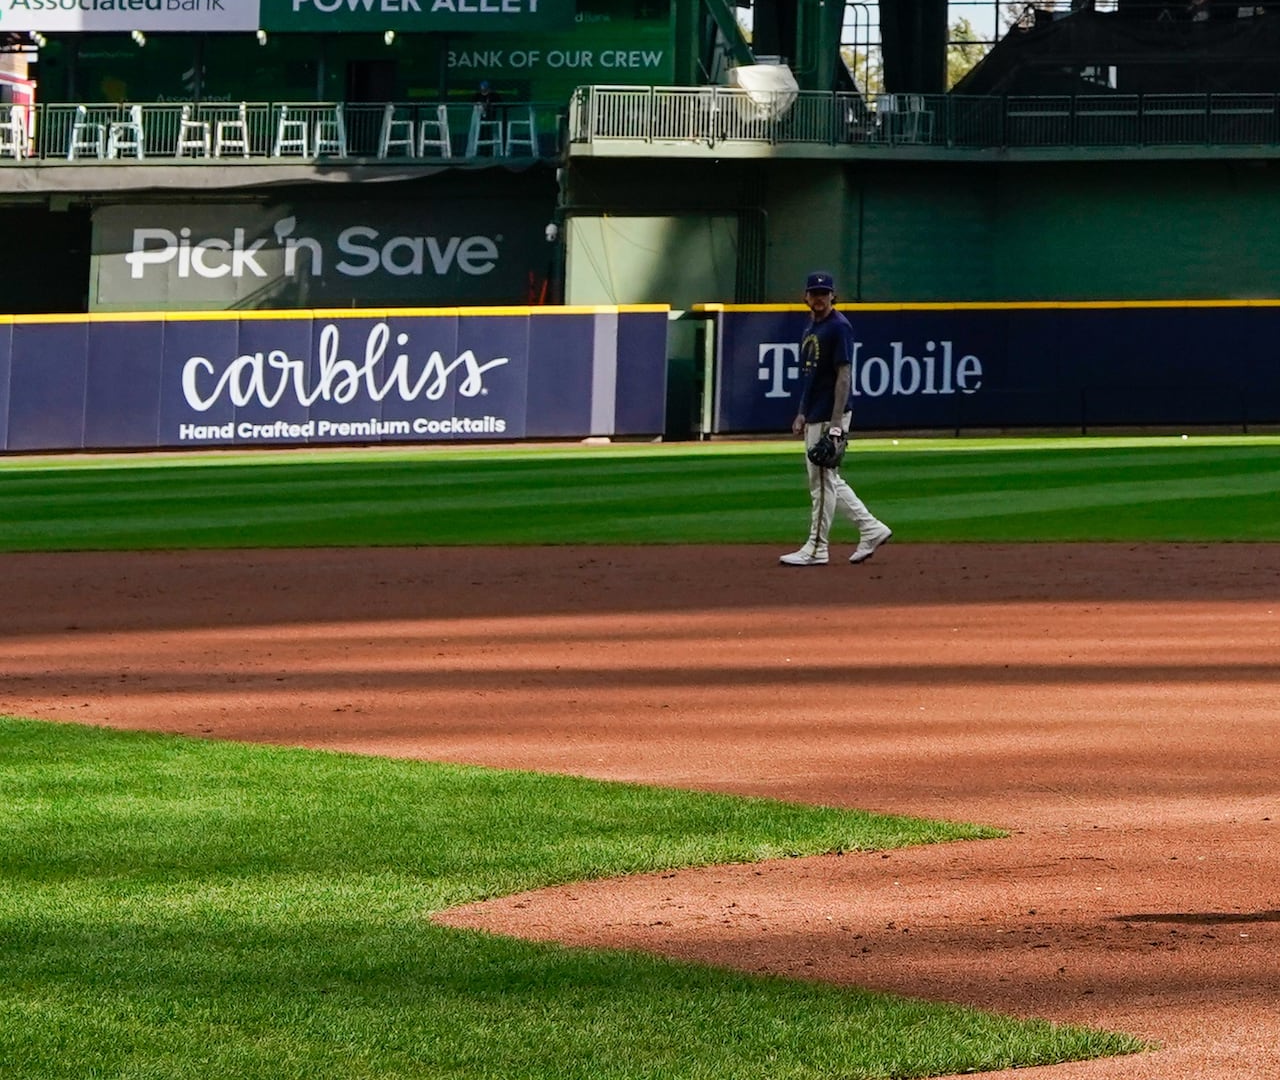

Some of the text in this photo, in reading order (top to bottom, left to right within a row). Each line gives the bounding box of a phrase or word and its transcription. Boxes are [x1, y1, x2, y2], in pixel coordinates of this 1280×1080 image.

[447, 51, 663, 68] BANK OF OUR CREW
[125, 227, 268, 279] Pick
[335, 226, 499, 277] Save
[182, 322, 510, 411] carbliss
[180, 416, 507, 440] Hand Crafted Premium Cocktails
